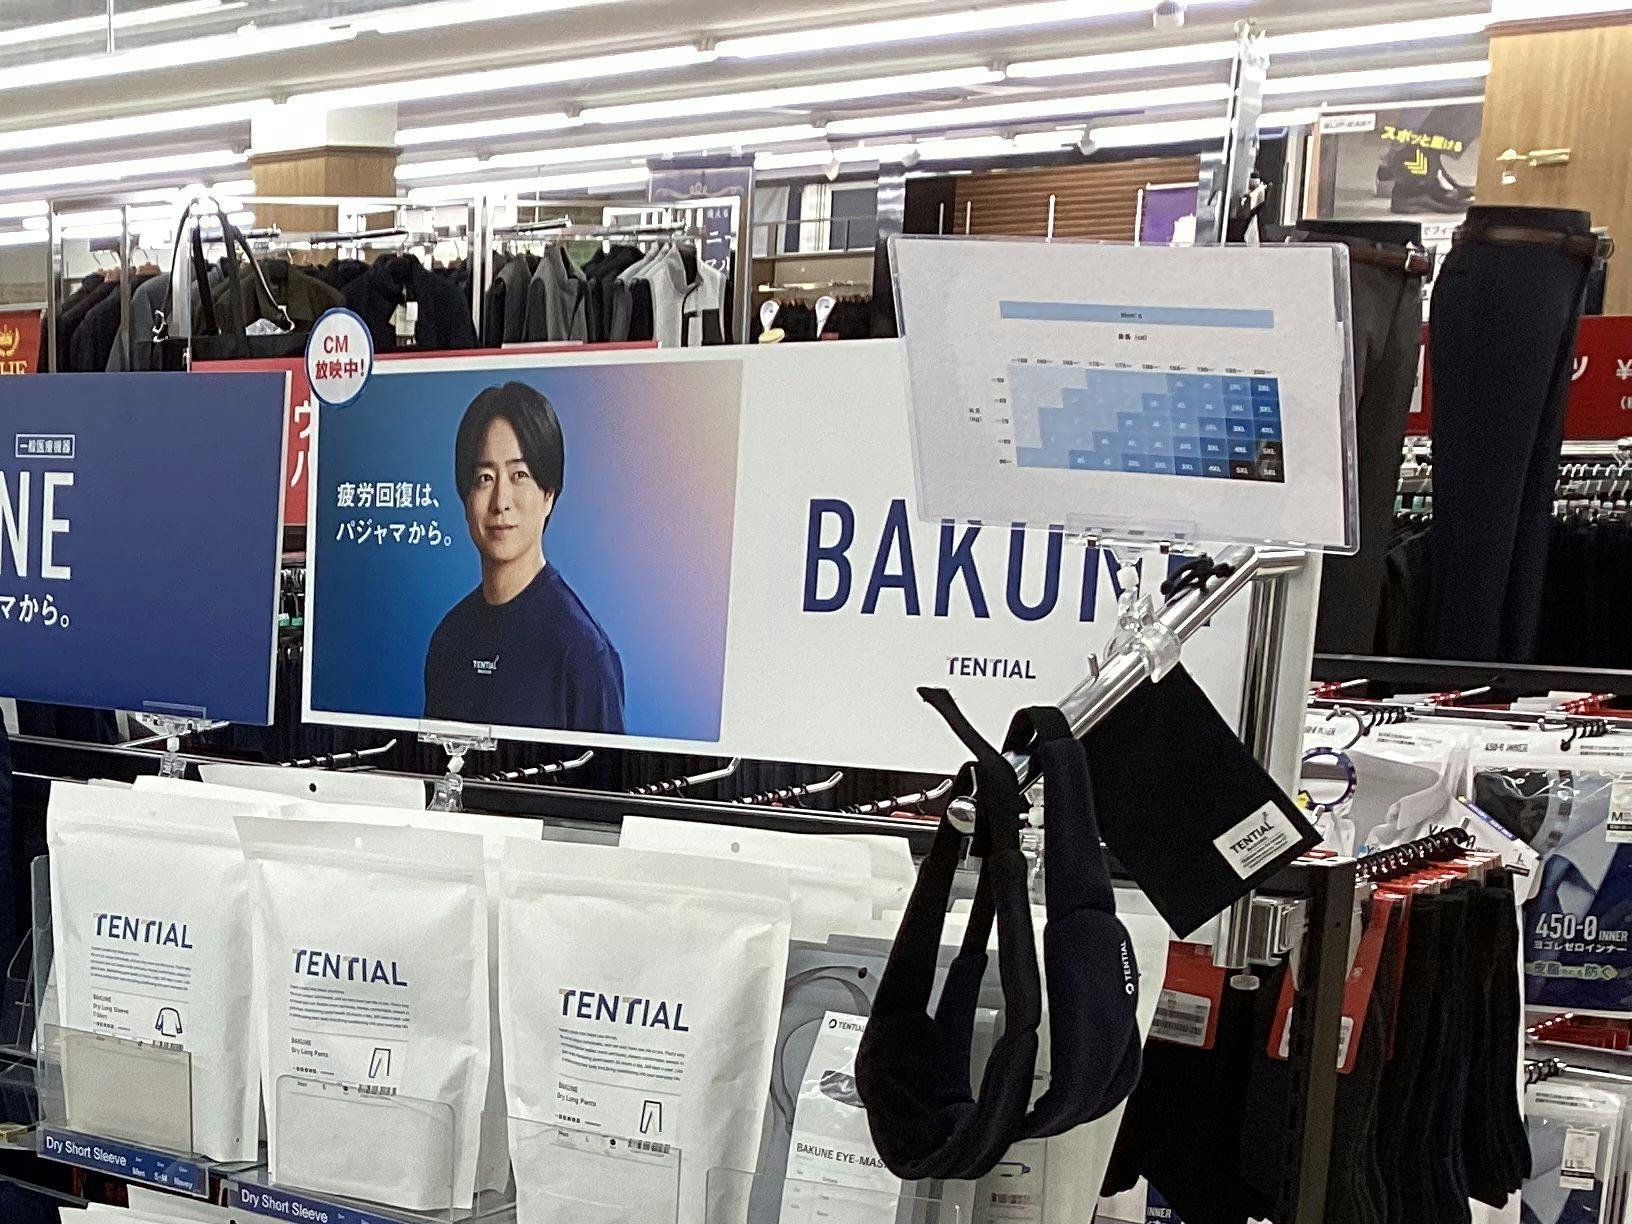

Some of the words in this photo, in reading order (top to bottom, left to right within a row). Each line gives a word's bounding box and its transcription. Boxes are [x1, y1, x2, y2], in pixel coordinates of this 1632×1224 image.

[323, 336, 348, 354] CM
[336, 480, 441, 510] 疲労回復は、
[335, 518, 454, 549] パジャマから。
[947, 656, 1036, 680] TENTIAL
[1611, 811, 1623, 822] M
[1229, 821, 1275, 855] TENTIAL
[93, 912, 193, 949] TENTIAL
[1535, 912, 1596, 941] 450-0
[1598, 929, 1628, 943] INNER
[1120, 940, 1133, 983] TENTIAL
[1533, 940, 1628, 953] ヨゴレゼロインナー
[292, 948, 408, 987] TENTIAL
[558, 988, 689, 1032] TENTIAL
[46, 1136, 62, 1154] Dry
[65, 1140, 92, 1159] Short
[92, 1146, 127, 1167] Sleeve
[796, 1142, 834, 1160] BAKUNE
[835, 1150, 889, 1170] EYE-MAS
[241, 1188, 259, 1207] Dry
[261, 1194, 289, 1214] Short
[291, 1201, 328, 1224] Sleeve
